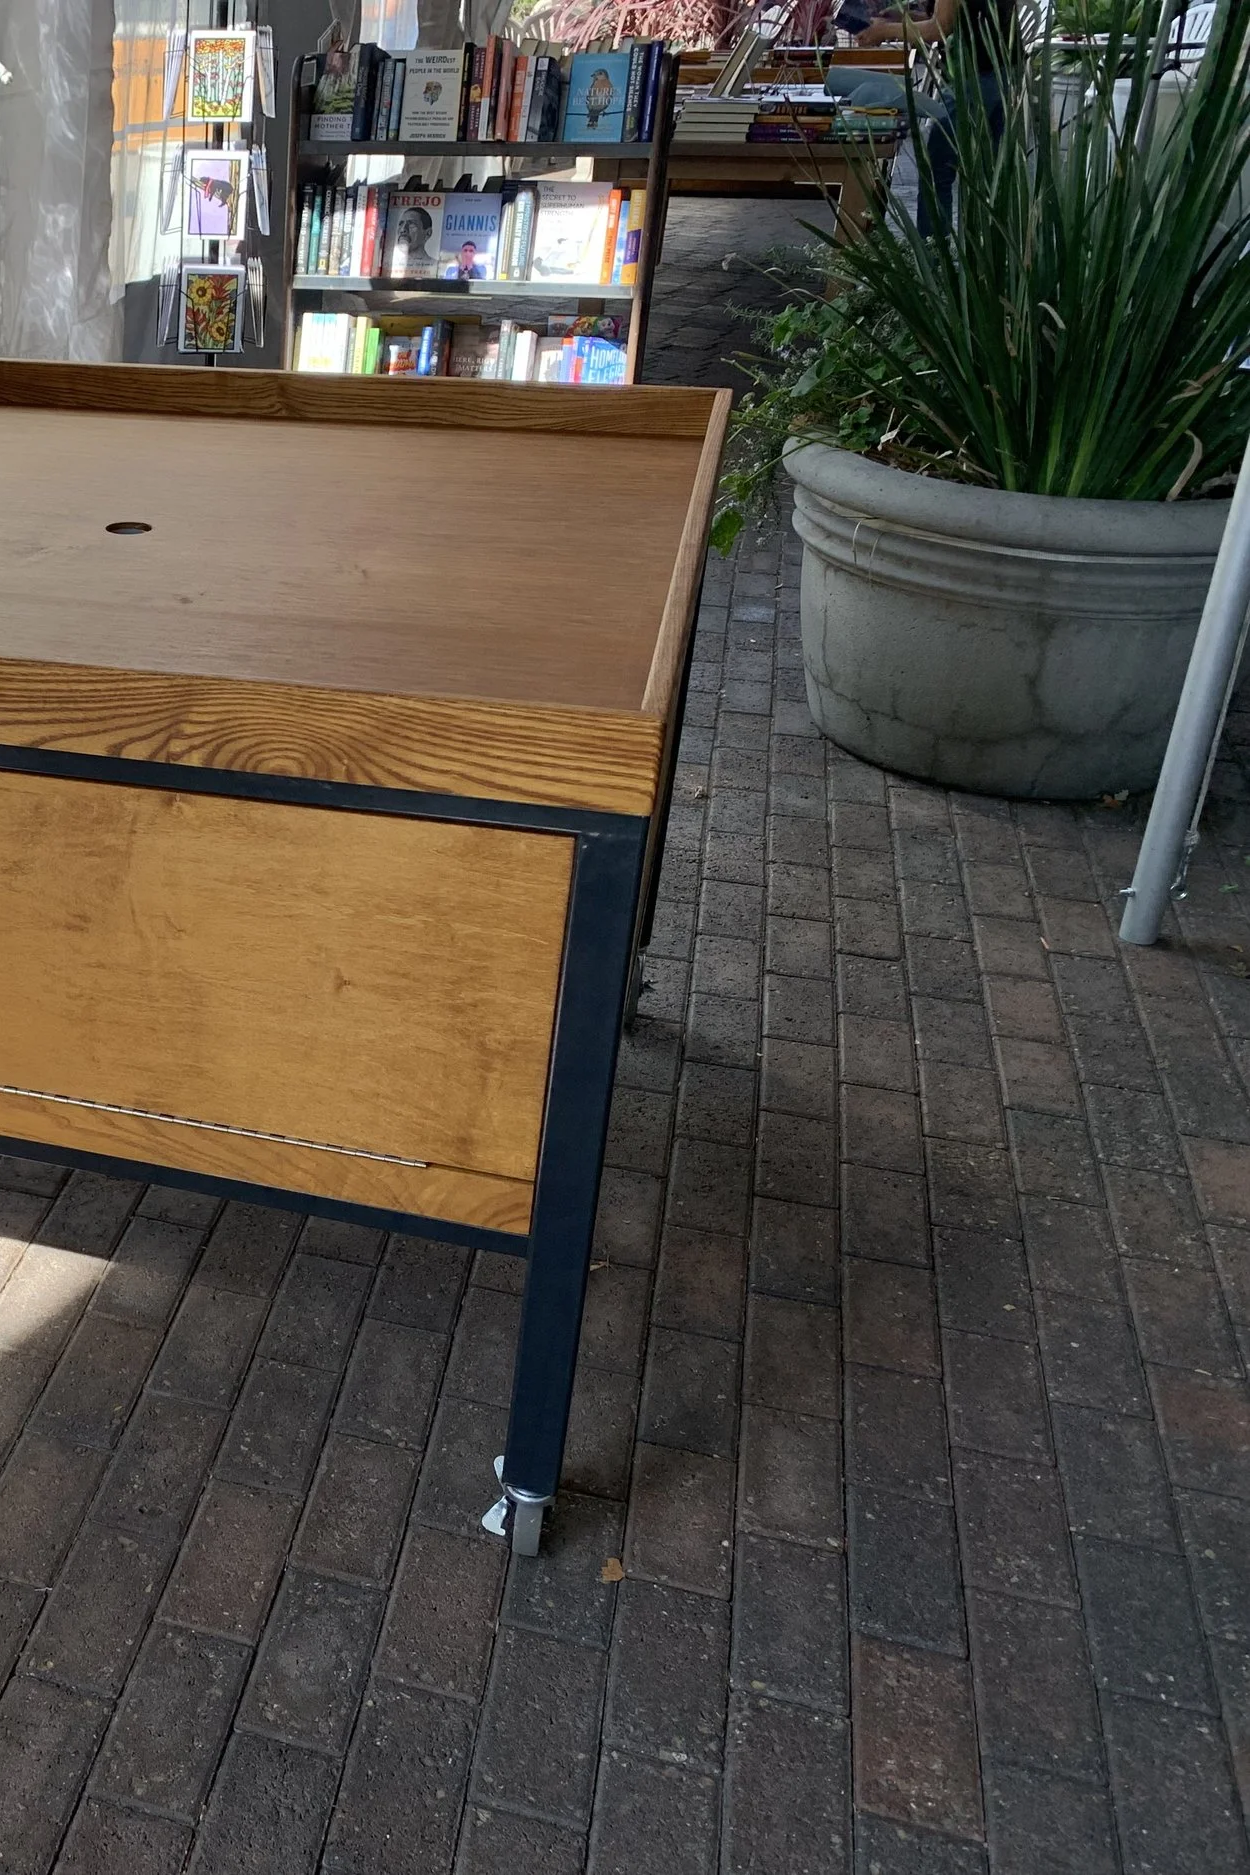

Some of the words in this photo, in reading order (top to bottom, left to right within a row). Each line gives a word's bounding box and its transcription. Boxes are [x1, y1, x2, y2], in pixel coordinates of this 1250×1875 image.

[573, 97, 596, 106] BEST
[597, 97, 623, 105] HOPE
[391, 196, 441, 206] TREJO
[301, 202, 310, 235] SPLENDID
[446, 214, 497, 231] GIANNIS
